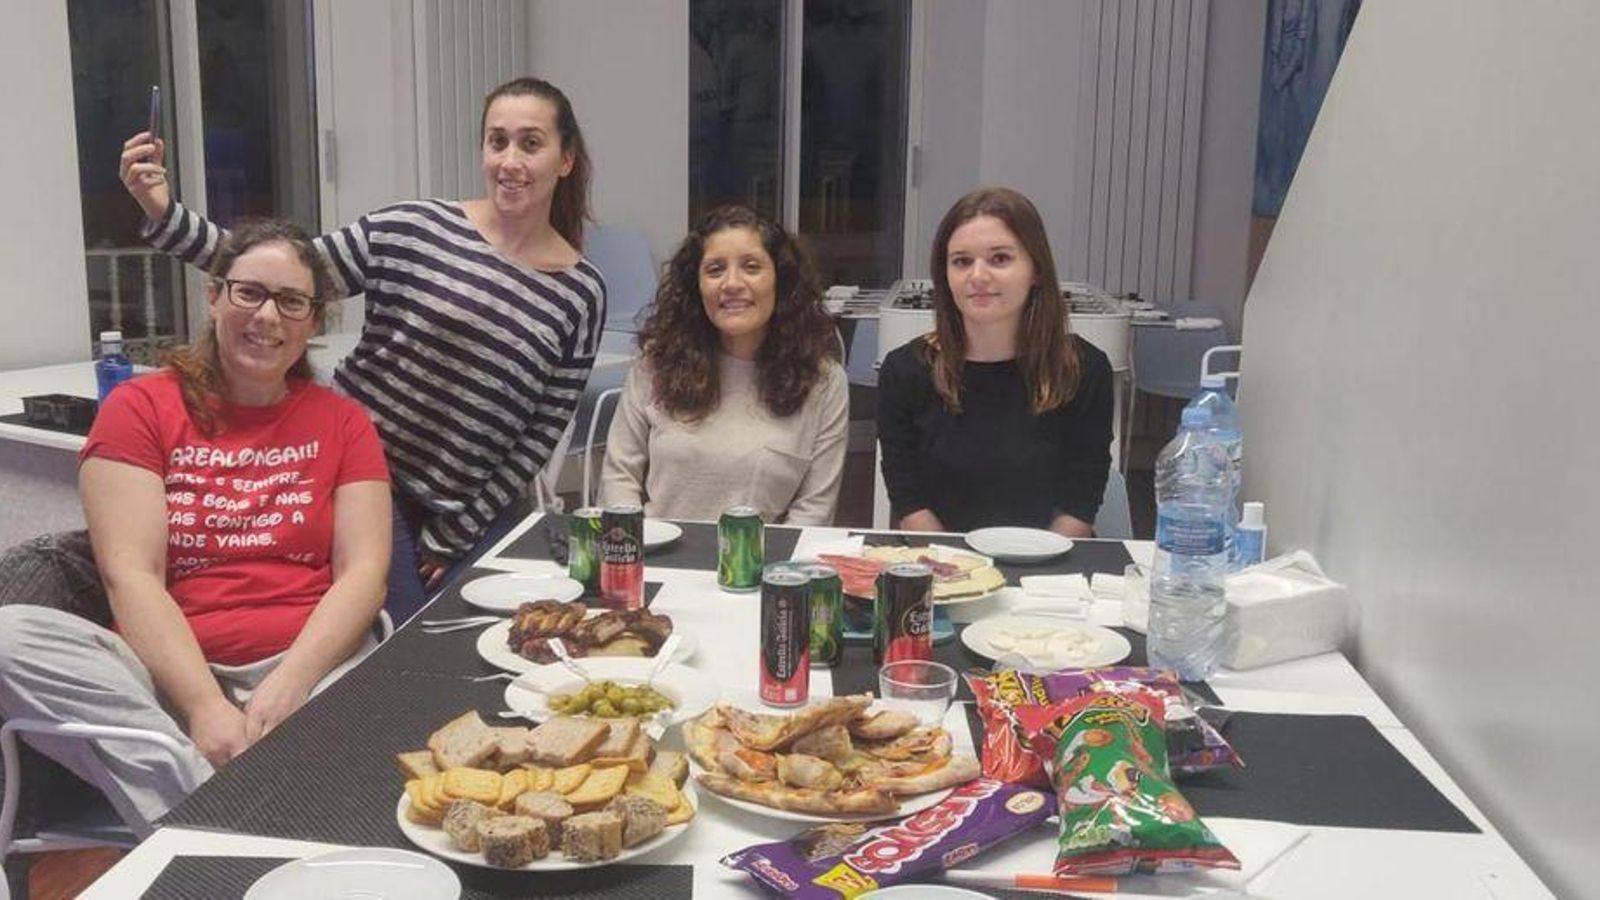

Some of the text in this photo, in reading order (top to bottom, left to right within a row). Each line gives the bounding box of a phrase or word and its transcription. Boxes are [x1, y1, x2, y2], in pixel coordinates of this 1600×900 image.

[275, 491, 313, 505] NAS
[204, 512, 283, 530] CONTIGO
[292, 510, 305, 525] A
